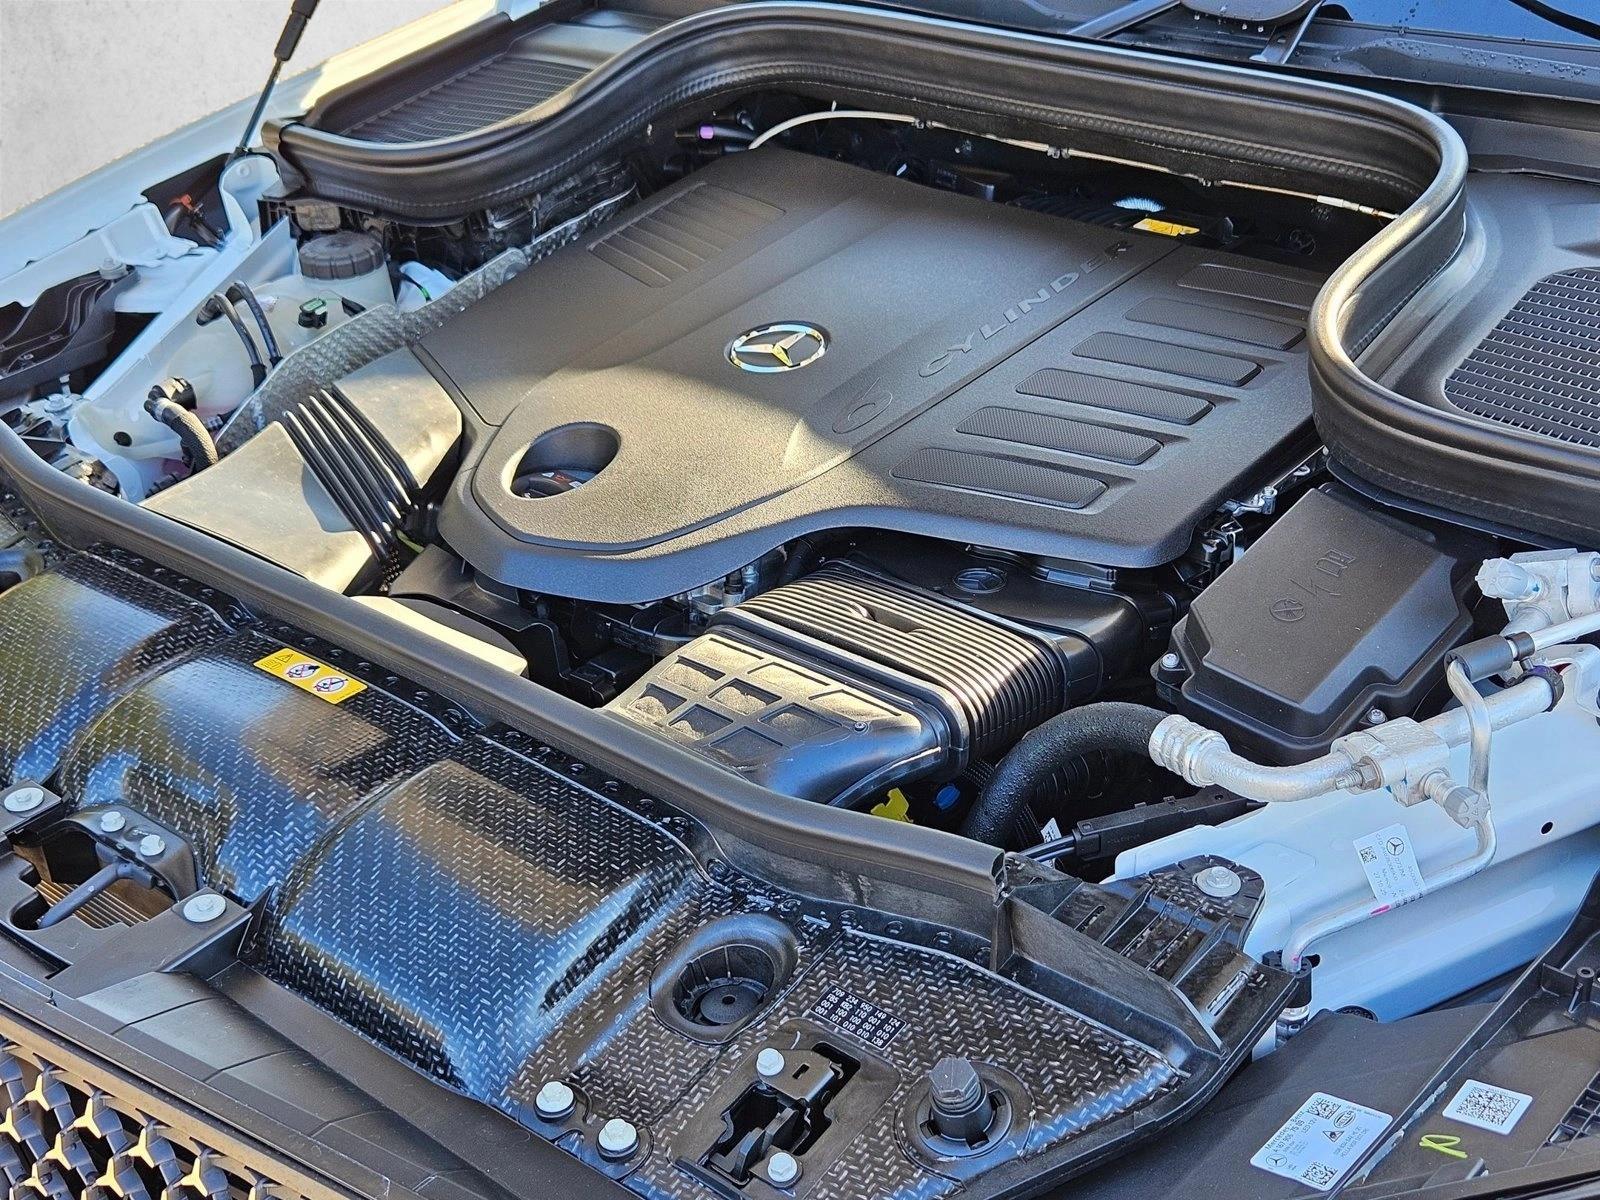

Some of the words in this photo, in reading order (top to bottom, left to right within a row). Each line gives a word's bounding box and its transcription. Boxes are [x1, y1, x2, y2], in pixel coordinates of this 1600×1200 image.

[832, 376, 893, 434] 6
[815, 1006, 828, 1016] 001
[830, 1014, 841, 1024] 101
[843, 1021, 856, 1031] 010
[857, 1029, 870, 1039] 010
[872, 1037, 884, 1047] 138
[821, 1000, 834, 1010] 001
[836, 1008, 848, 1017] 100
[850, 1015, 862, 1025] 100
[862, 1023, 875, 1033] 001
[876, 1030, 890, 1040] 010
[832, 988, 845, 997] 709
[846, 995, 859, 1005] 234
[889, 1018, 901, 1027] 124
[855, 1009, 867, 1019] 110
[868, 1016, 881, 1026] 001
[883, 1024, 895, 1034] 101
